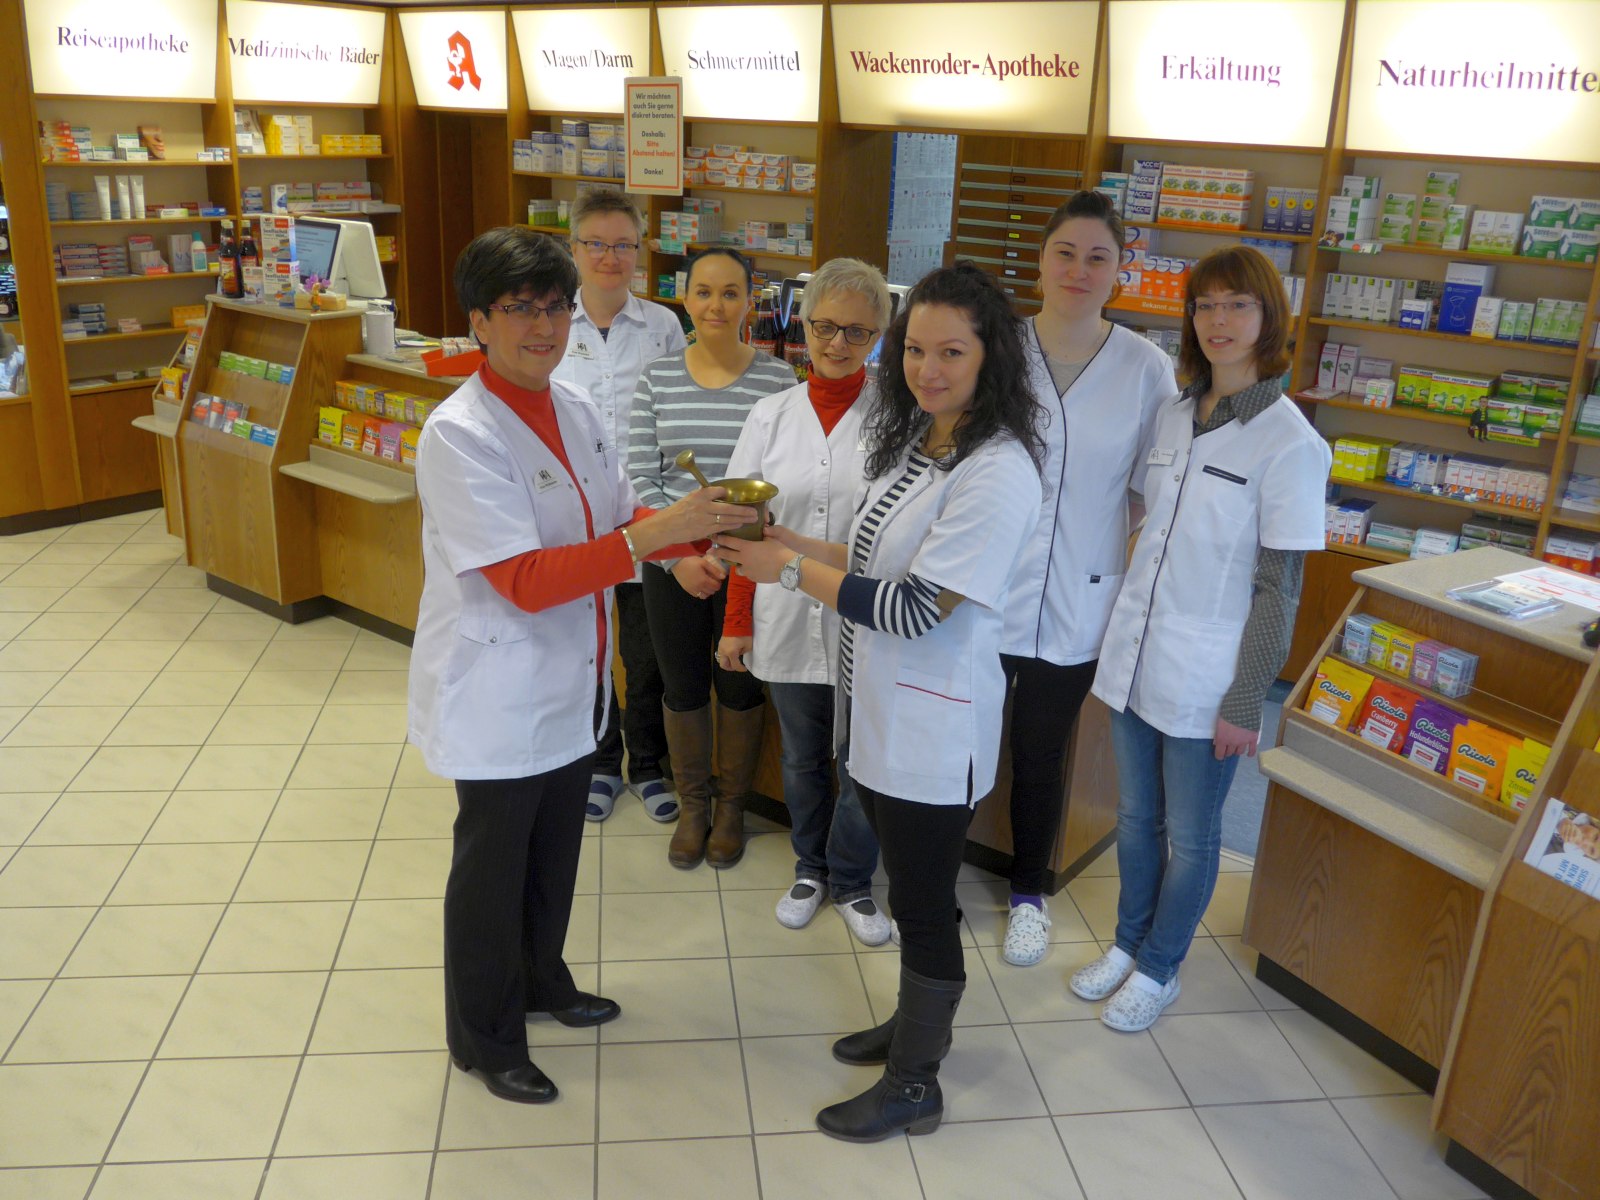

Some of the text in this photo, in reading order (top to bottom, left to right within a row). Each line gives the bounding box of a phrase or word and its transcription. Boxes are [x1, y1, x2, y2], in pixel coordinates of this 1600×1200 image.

[57, 26, 189, 54] Reiseapotheke
[228, 37, 380, 65] Medizinische Bäder
[542, 49, 633, 69] Magen/Darm
[687, 49, 801, 72] Schmerzmittel
[850, 50, 1080, 81] Wackenroder-Apotheke
[1161, 54, 1282, 88] Erkältung
[1377, 59, 1600, 93] Naturheilmitte
[647, 92, 671, 100] möchten
[657, 103, 674, 111] gerne
[641, 130, 666, 138] Deshalb:
[632, 149, 655, 157] Abstand
[644, 168, 664, 176] Danke!
[1346, 624, 1365, 636] Ricola
[1392, 638, 1411, 650] Ricola
[1438, 656, 1459, 669] Ricola
[1320, 680, 1352, 702] Ricola
[1372, 696, 1408, 721] Ricola
[1371, 710, 1398, 729] Cranberry
[1416, 718, 1451, 742] Ricola
[1409, 730, 1449, 753] Holunderblüten
[1457, 743, 1496, 767] Ricola
[1515, 768, 1537, 784] Ric
